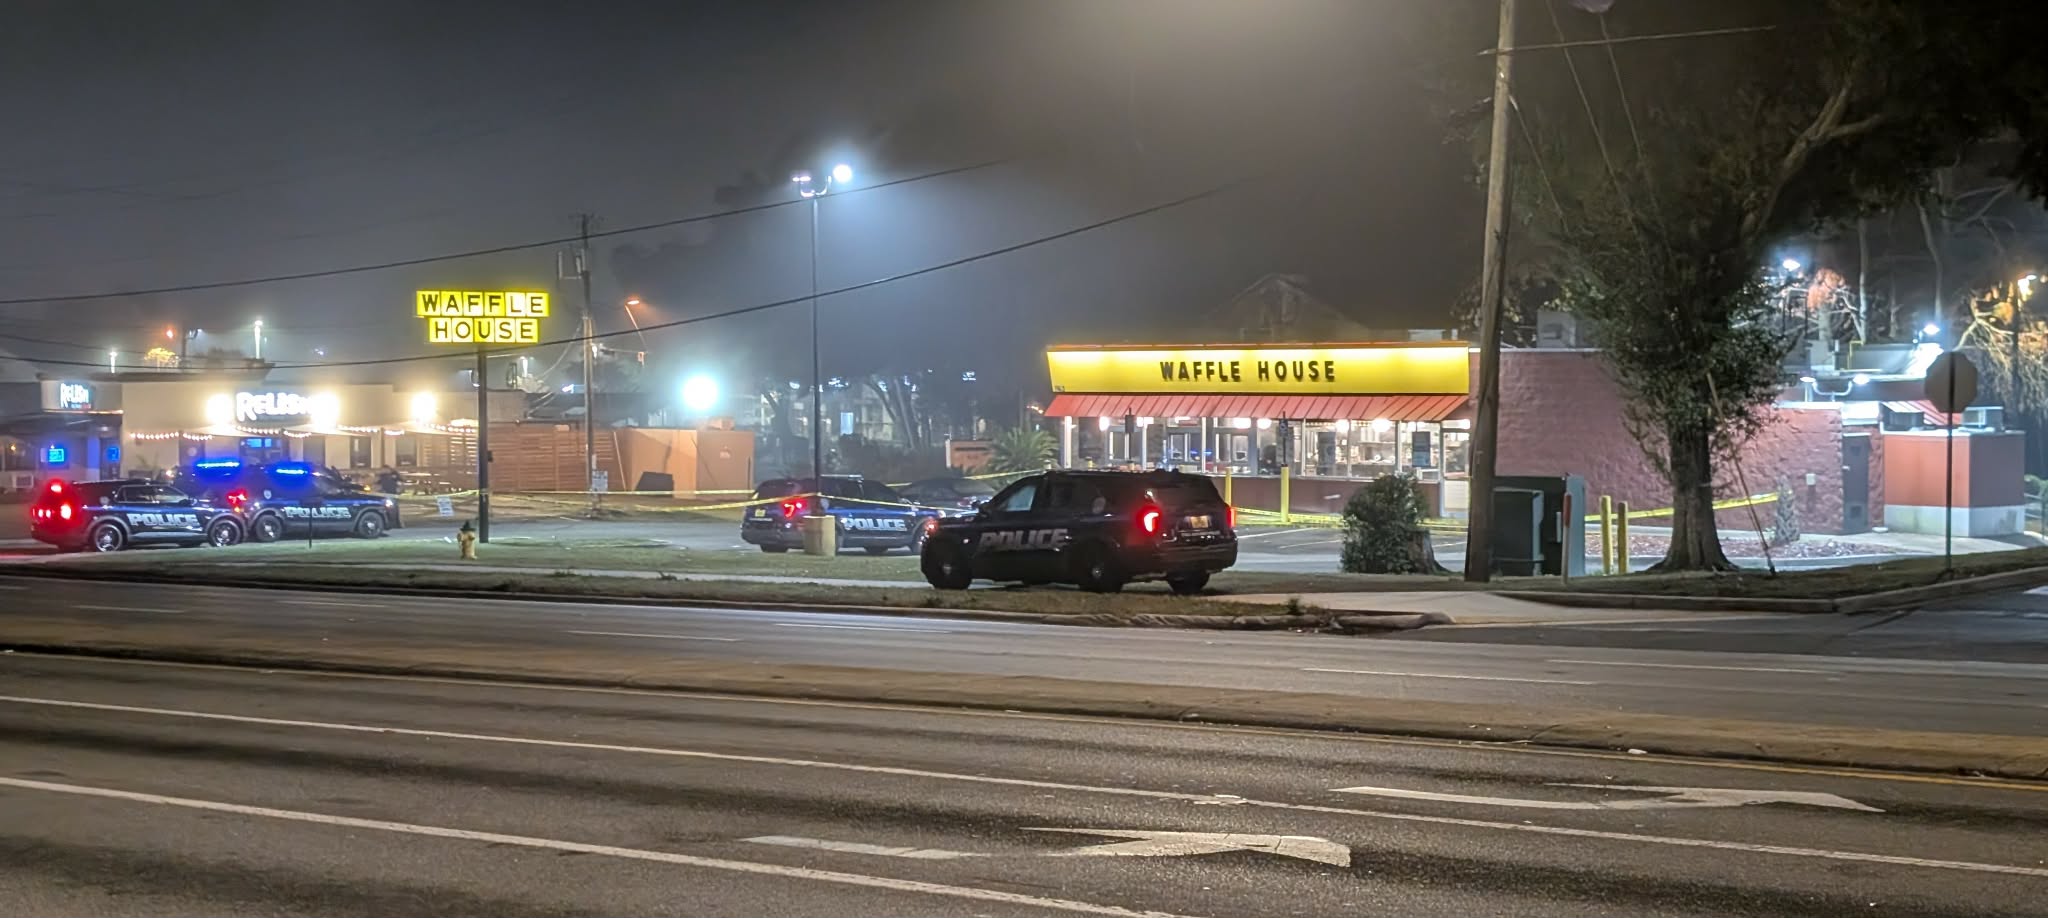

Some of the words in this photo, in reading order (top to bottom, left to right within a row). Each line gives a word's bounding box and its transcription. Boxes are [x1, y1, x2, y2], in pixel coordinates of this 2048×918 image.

[421, 293, 543, 313] WAFFLE
[434, 320, 534, 339] HOUSE
[1160, 361, 1241, 382] WAFFLE
[1258, 360, 1336, 382] HOUSE
[126, 513, 200, 526] POLICE
[282, 506, 352, 518] POLICE
[841, 517, 907, 531] POLICE
[979, 528, 1069, 551] POLICE
